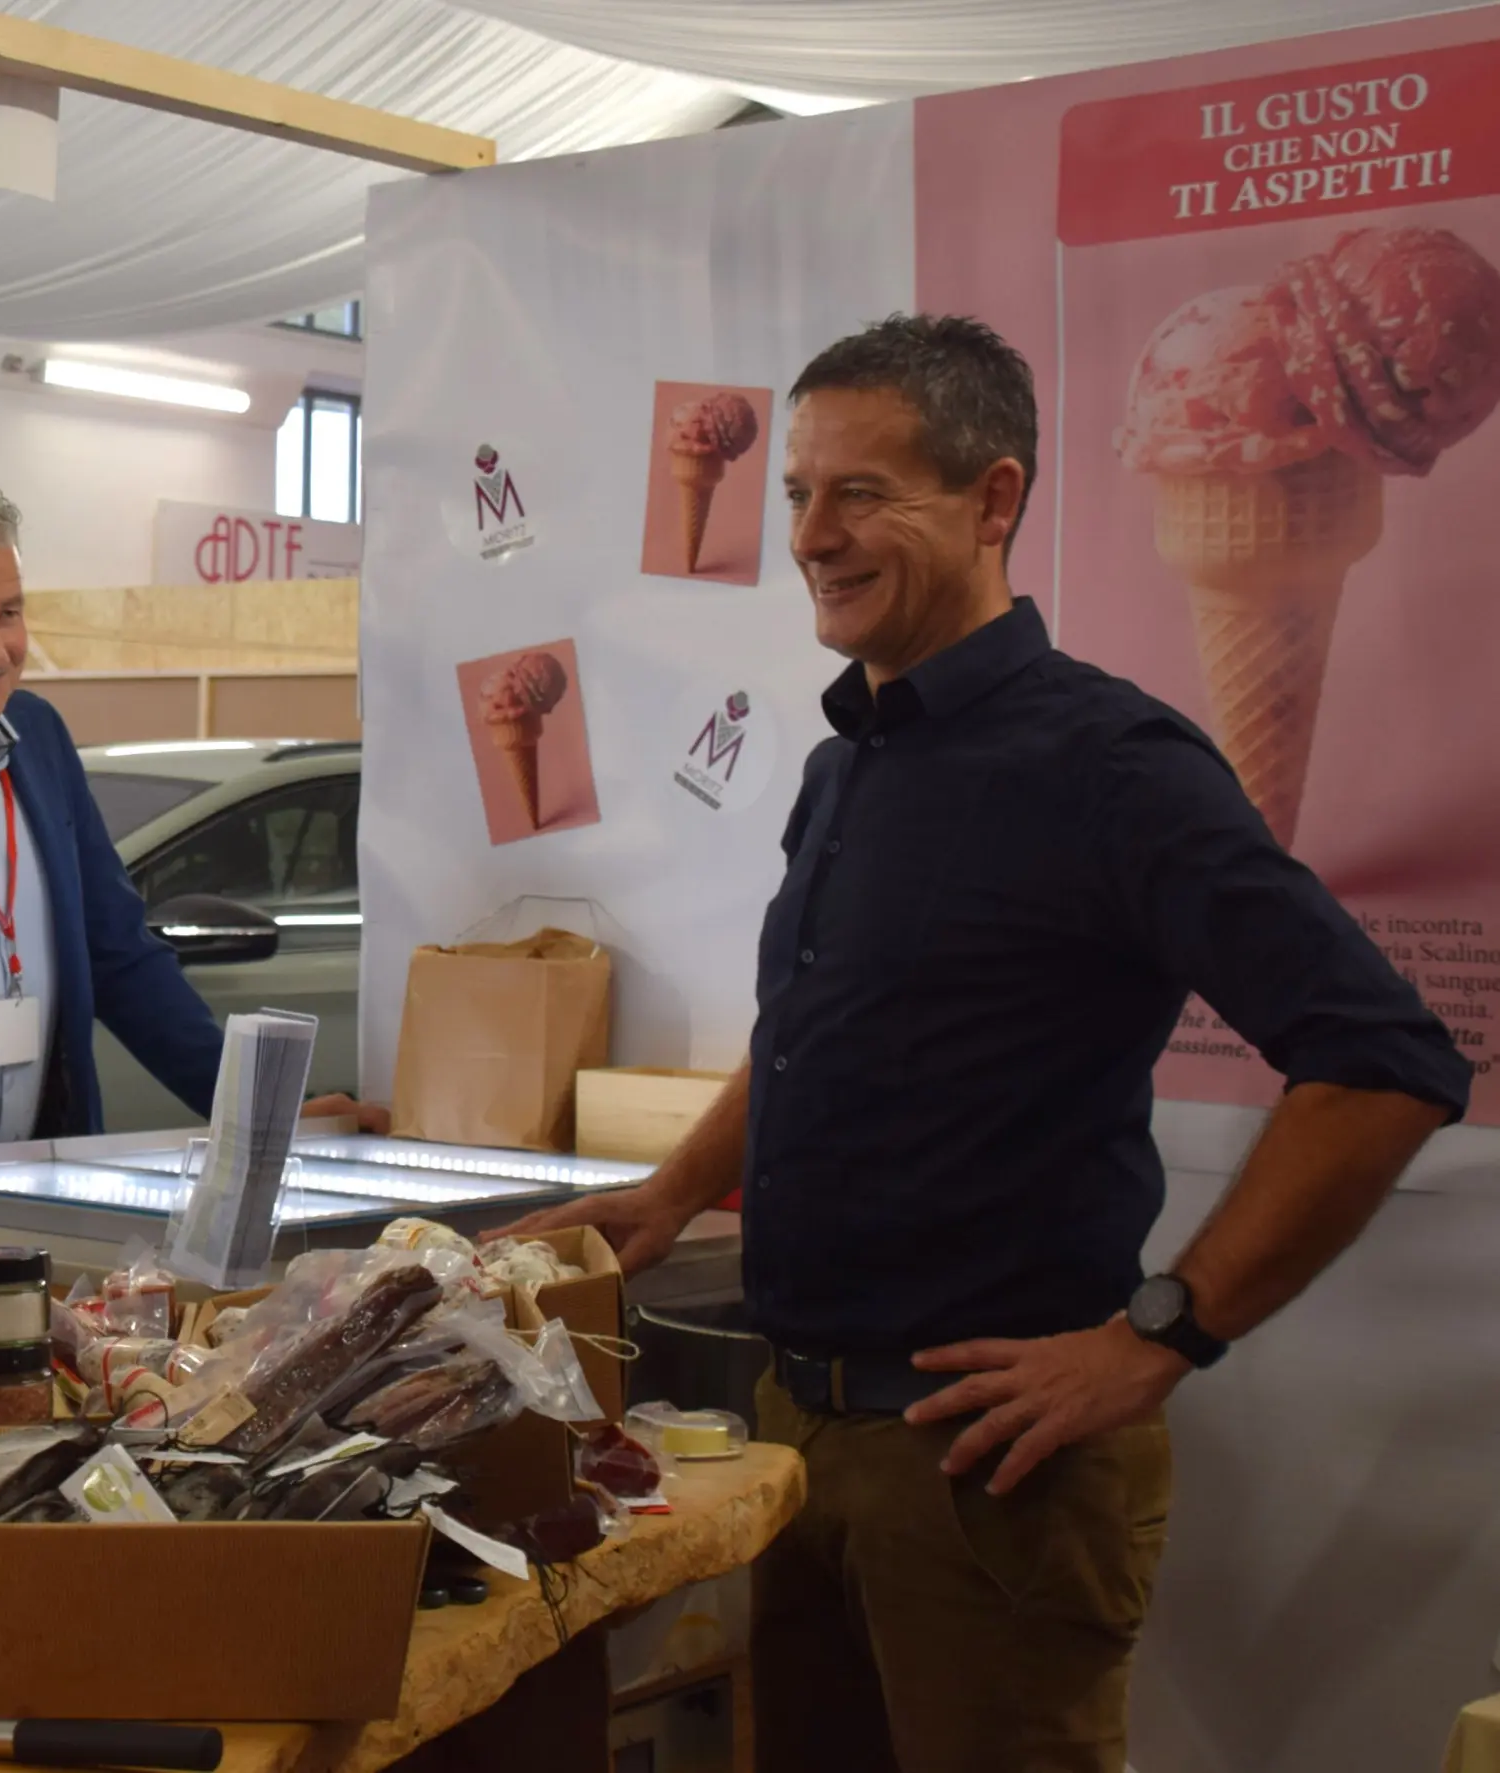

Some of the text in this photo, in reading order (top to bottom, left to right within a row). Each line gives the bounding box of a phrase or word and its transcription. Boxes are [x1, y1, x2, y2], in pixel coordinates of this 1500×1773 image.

[1199, 73, 1428, 139] IL GUSTO
[1223, 122, 1400, 172] CHE NON
[1170, 147, 1452, 219] TI ASPETTI!
[1386, 913, 1483, 936] incontra
[1425, 973, 1500, 998] sangue
[1167, 1036, 1252, 1062] assione,
